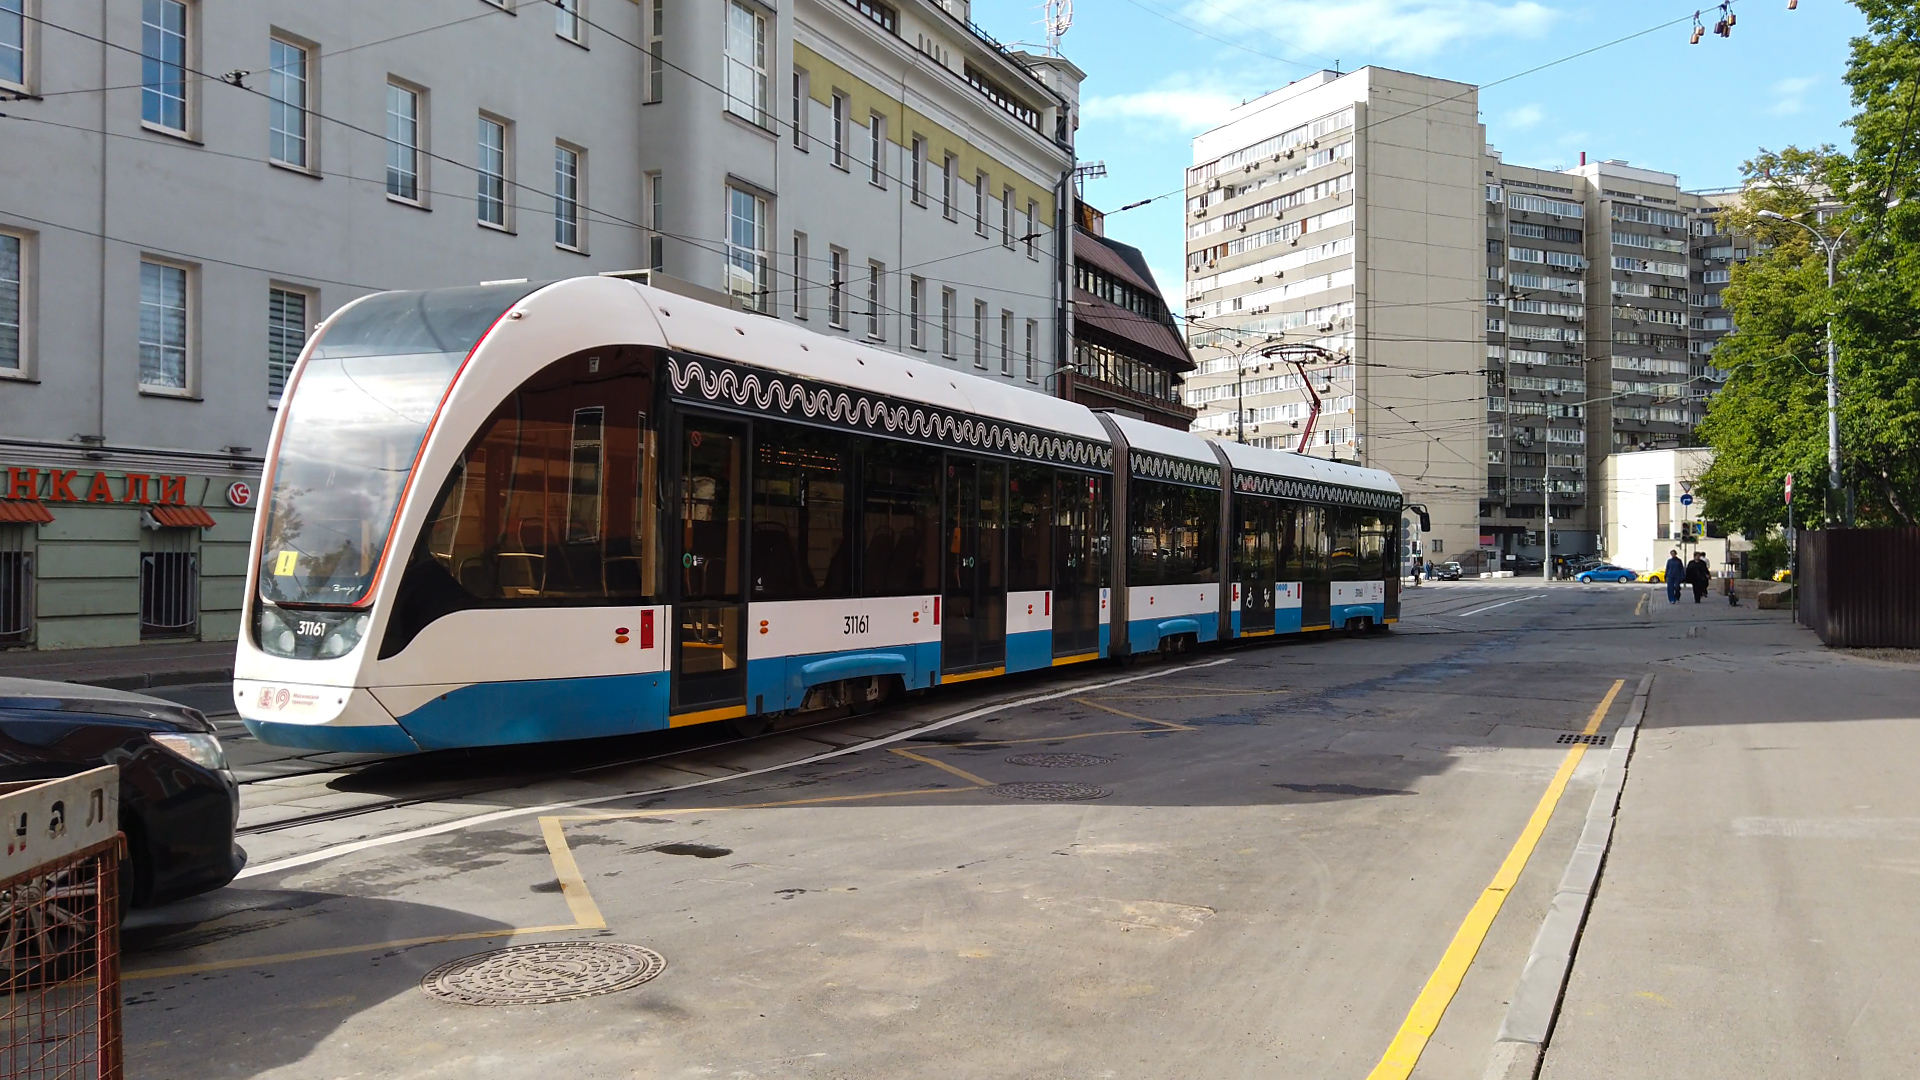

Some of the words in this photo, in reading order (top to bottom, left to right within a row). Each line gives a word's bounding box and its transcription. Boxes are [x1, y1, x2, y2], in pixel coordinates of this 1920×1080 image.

[7, 467, 187, 505] НКАЛИ
[297, 620, 326, 637] 31161
[843, 615, 869, 635] 31161
